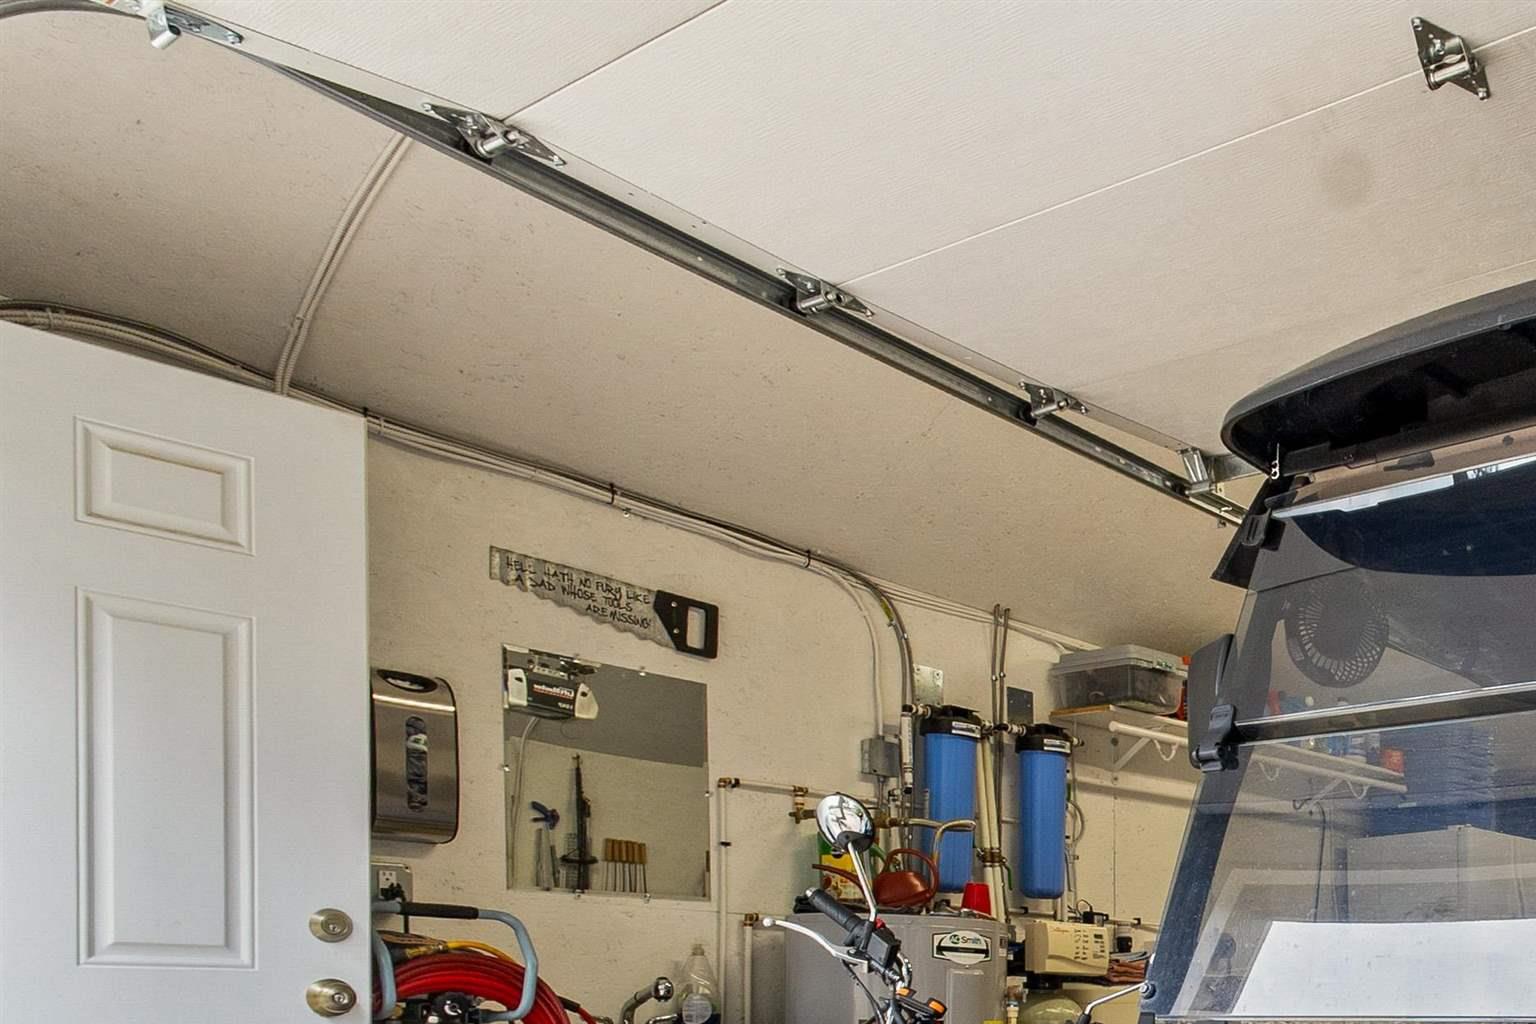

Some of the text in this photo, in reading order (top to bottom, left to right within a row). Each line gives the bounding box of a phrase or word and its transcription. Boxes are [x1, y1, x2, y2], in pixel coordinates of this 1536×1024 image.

[506, 555, 650, 604] HELL HATH NO FURY LIKE
[514, 574, 633, 612] A DAD WHOSE TOOLS
[585, 604, 608, 617] ARE
